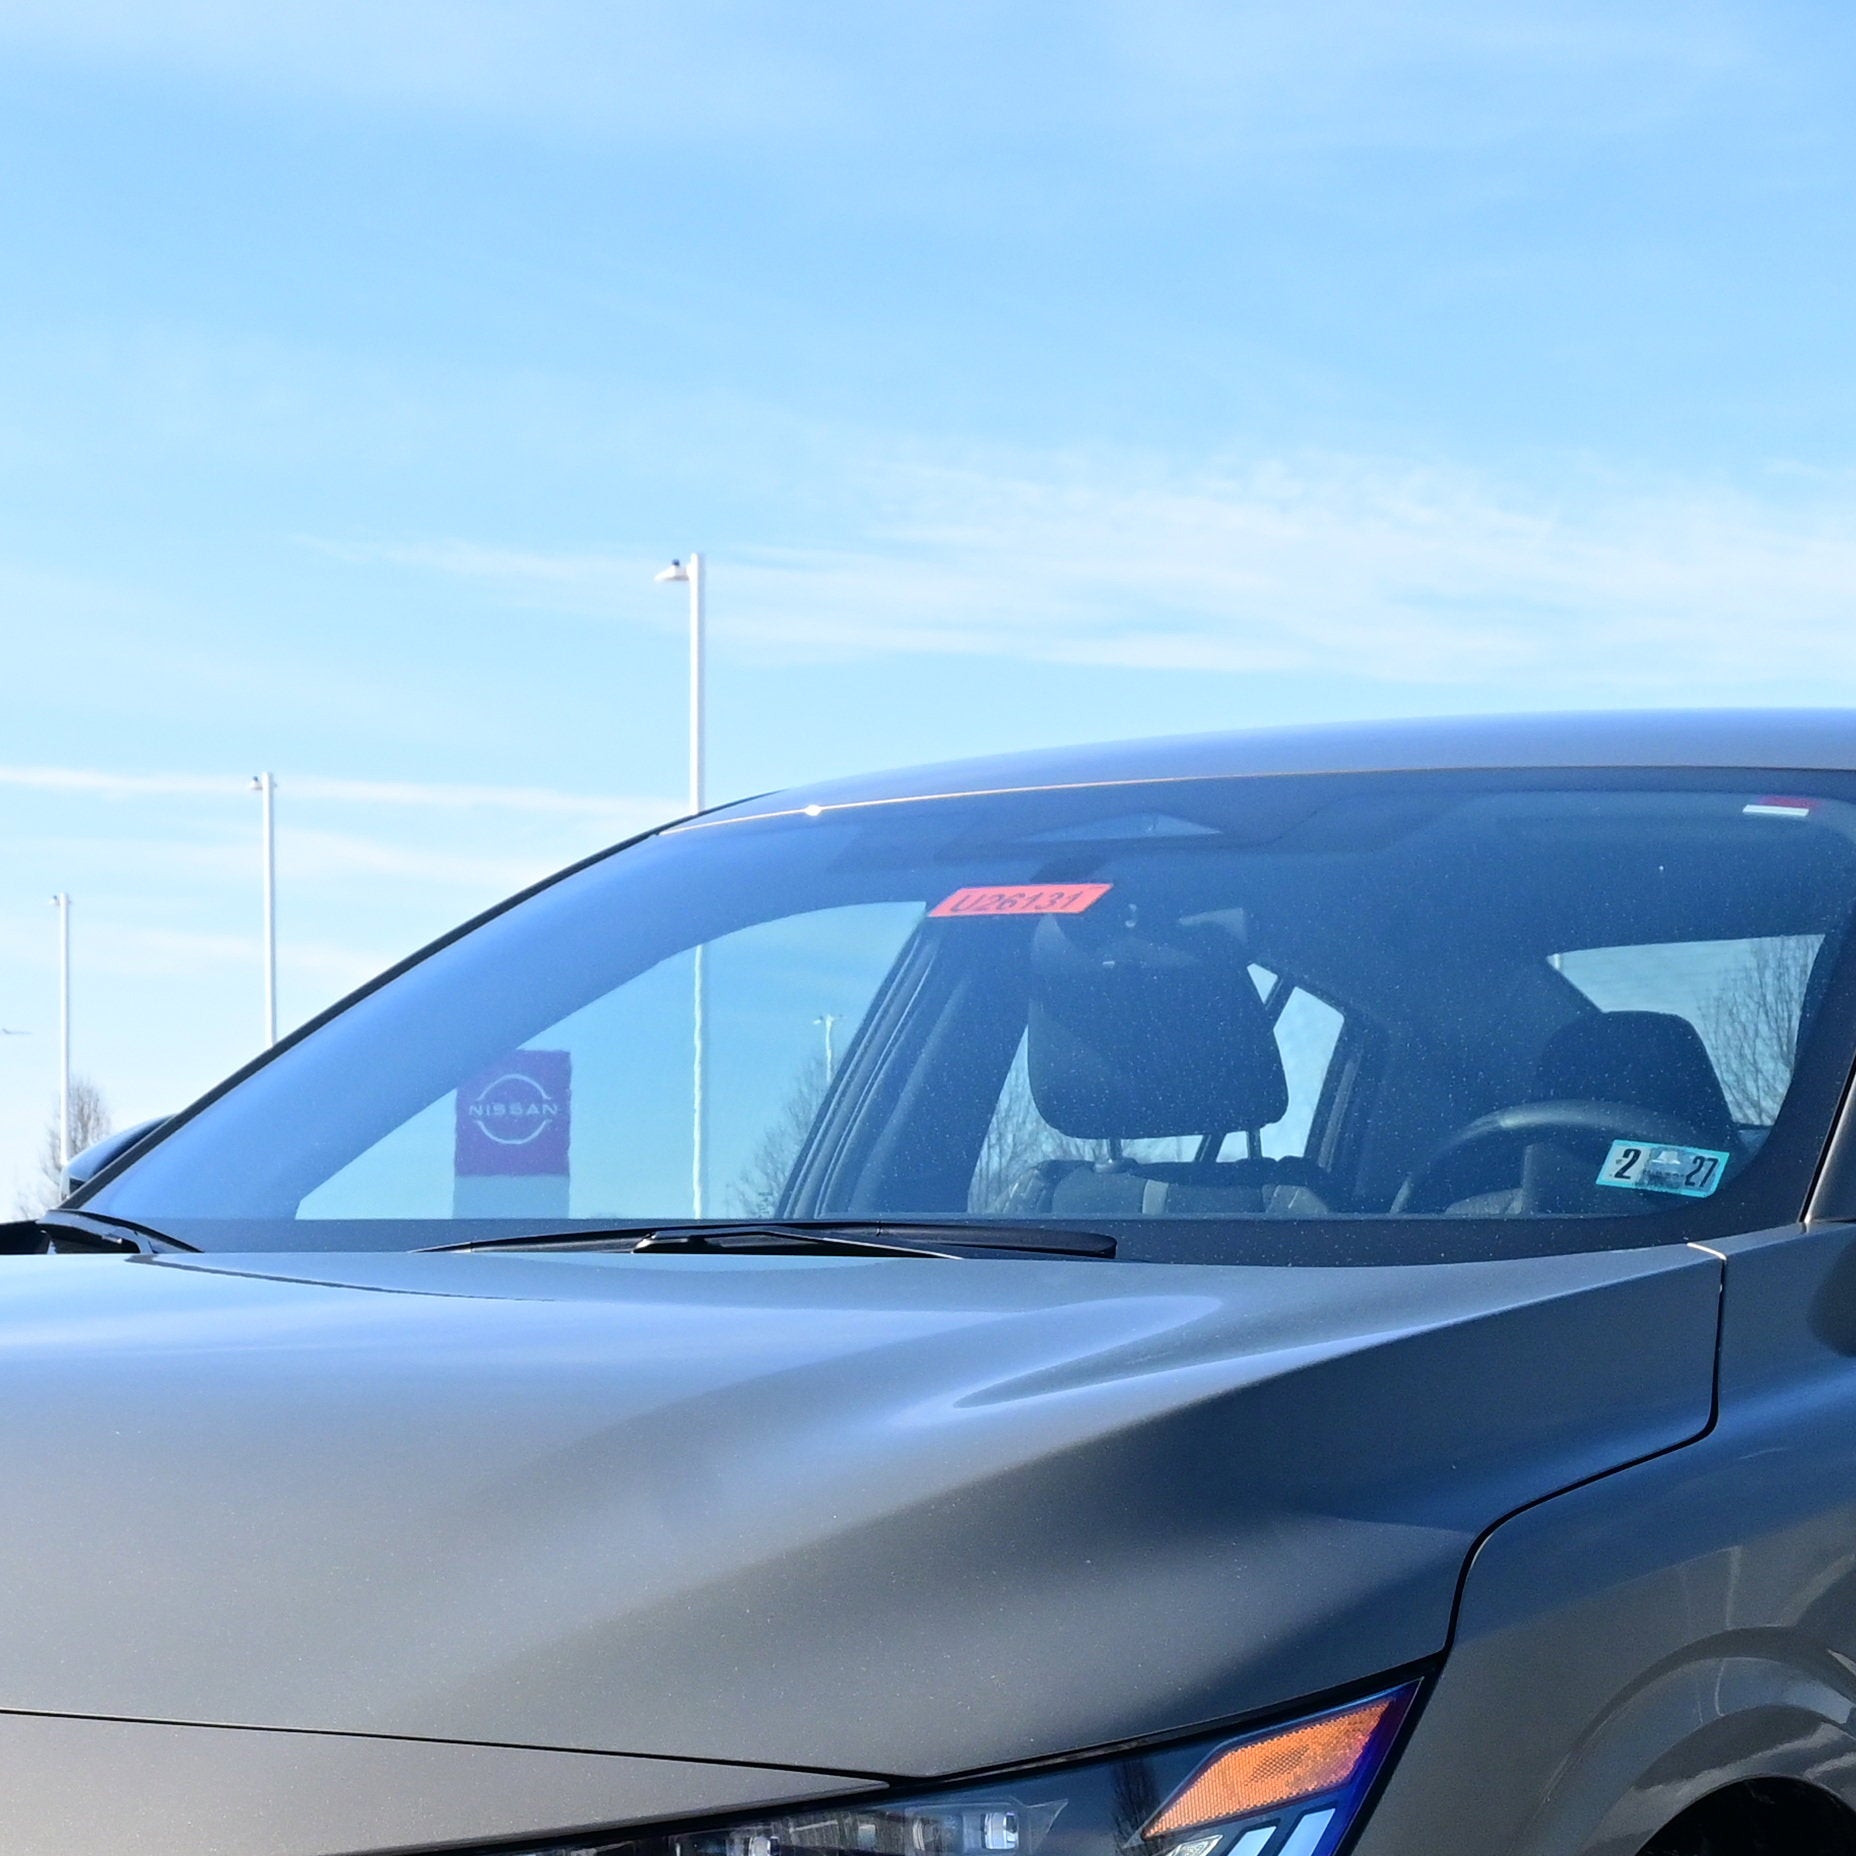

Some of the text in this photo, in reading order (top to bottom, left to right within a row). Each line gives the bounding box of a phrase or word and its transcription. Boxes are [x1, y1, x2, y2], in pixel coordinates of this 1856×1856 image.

[950, 891, 1083, 913] U26131
[469, 1102, 558, 1116] NISSAN
[1614, 1148, 1641, 1179] 2
[1685, 1156, 1719, 1188] 27
